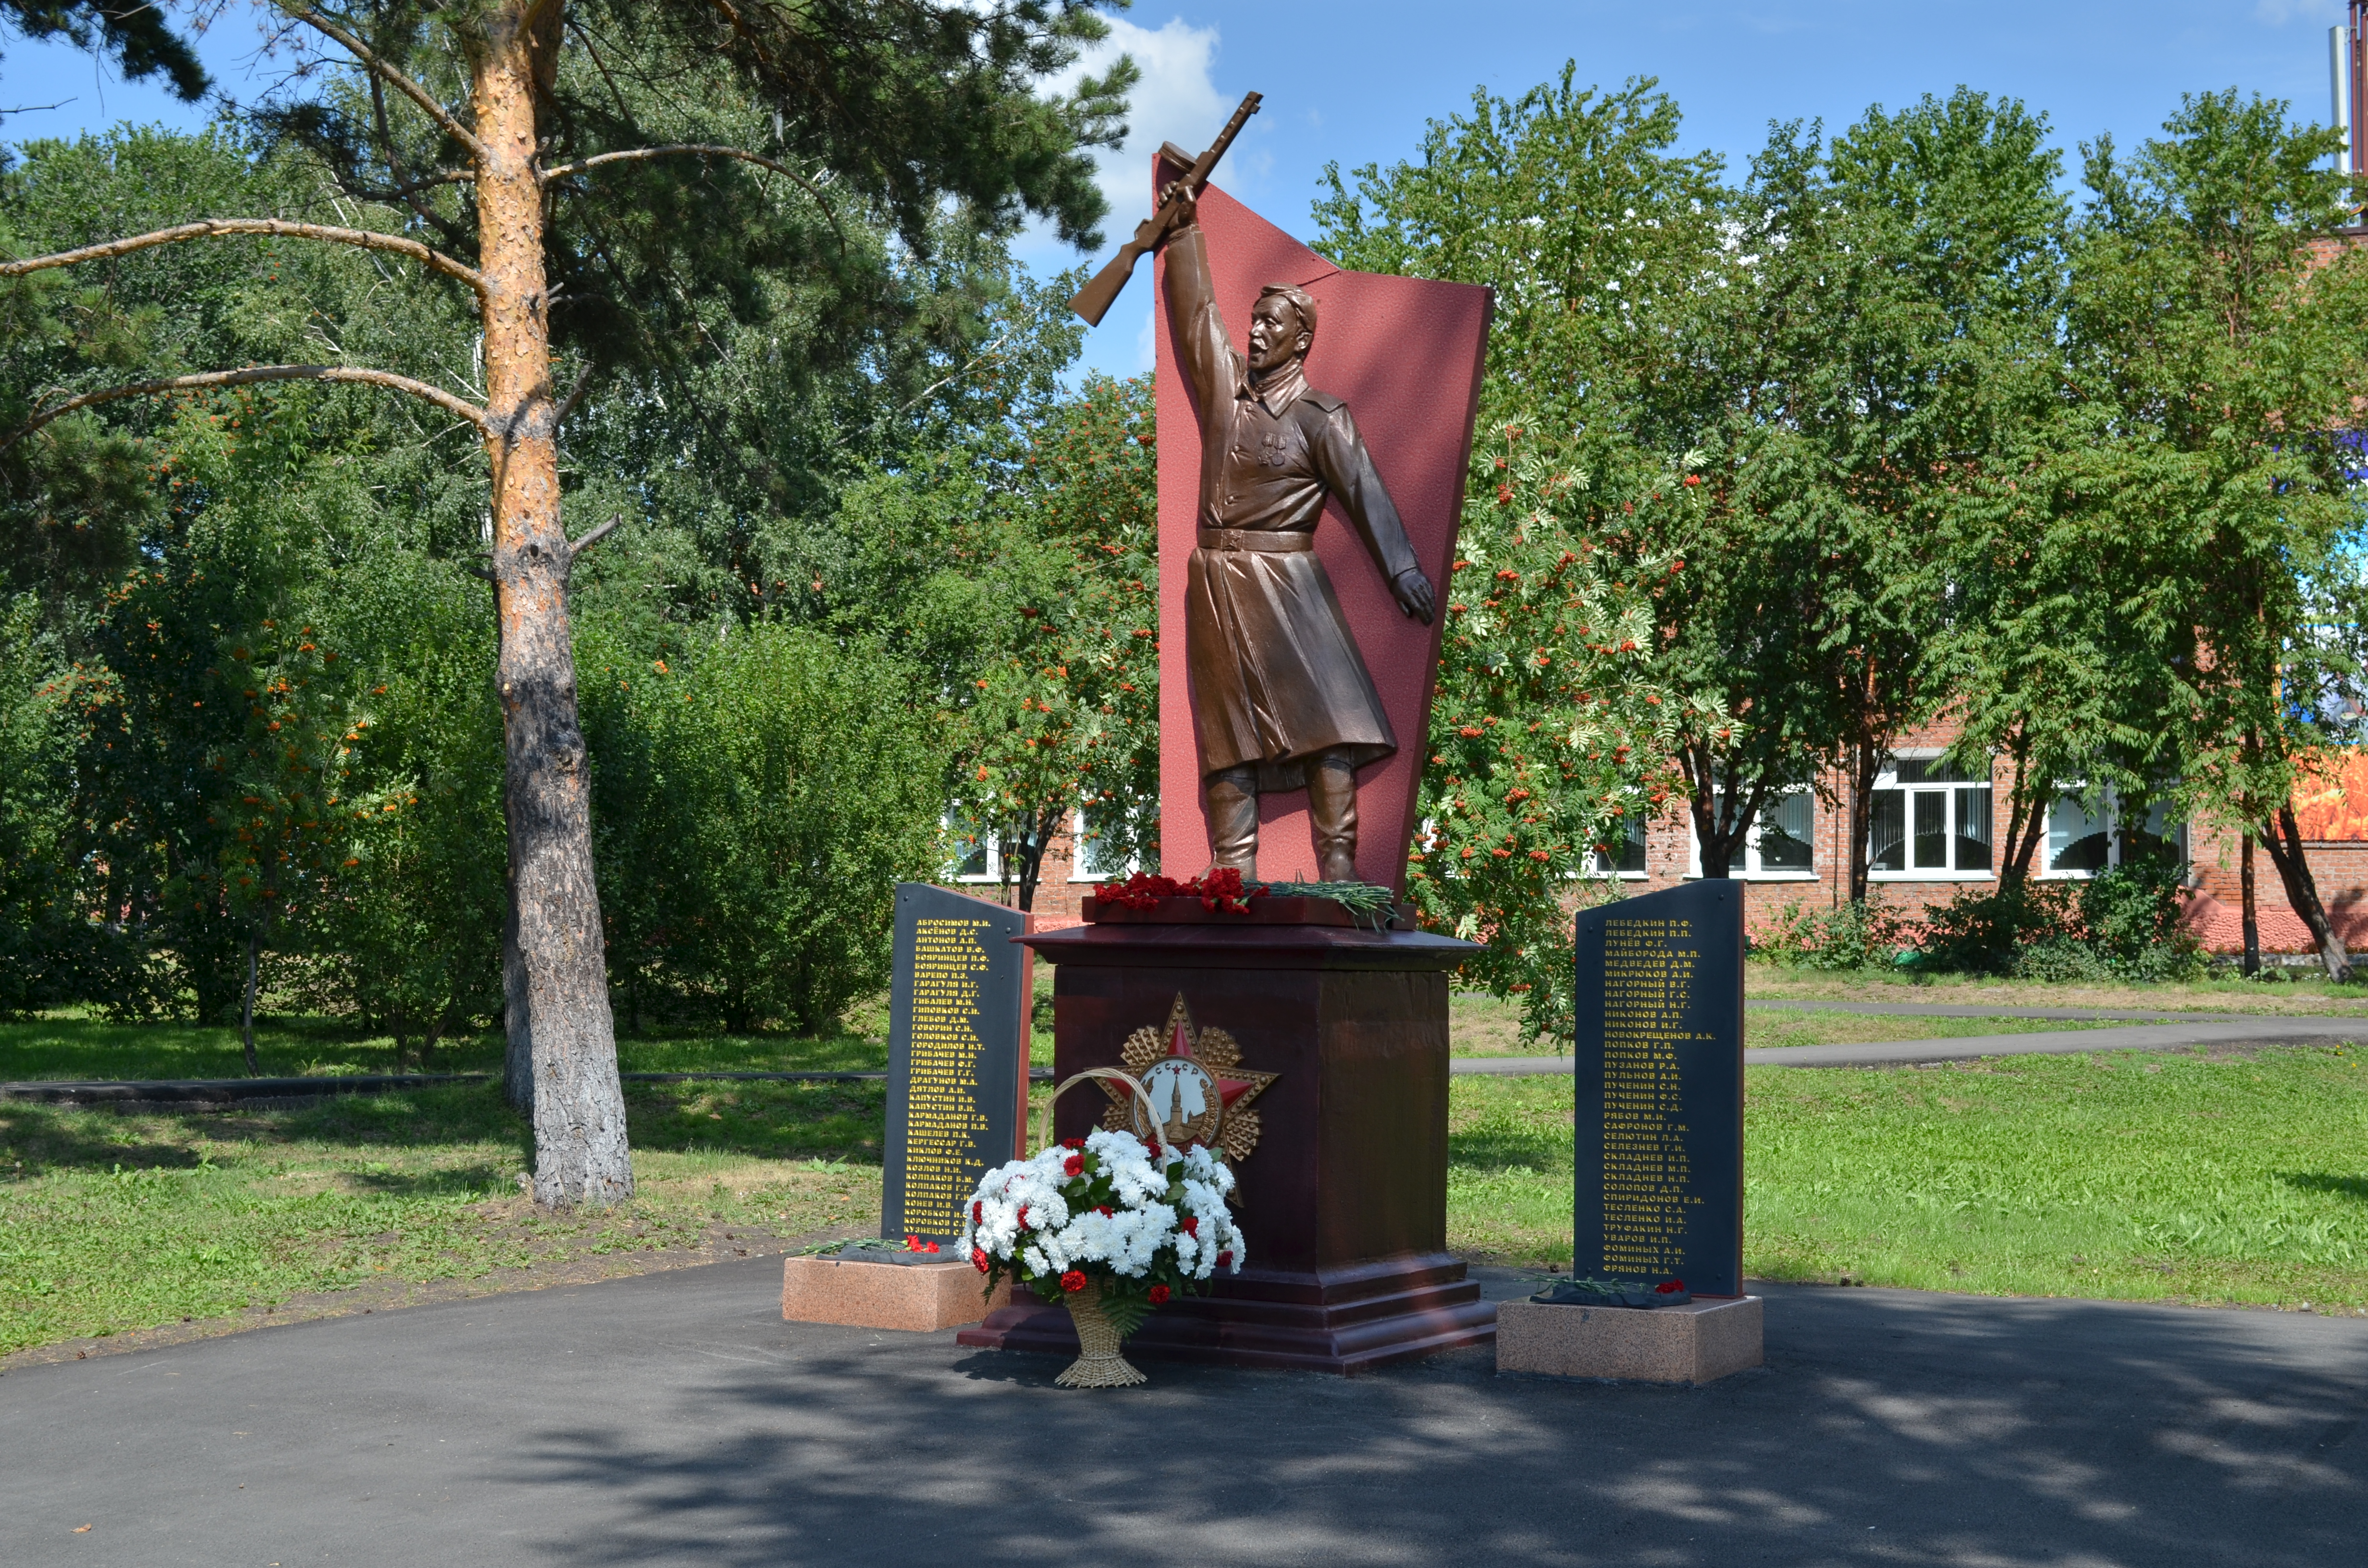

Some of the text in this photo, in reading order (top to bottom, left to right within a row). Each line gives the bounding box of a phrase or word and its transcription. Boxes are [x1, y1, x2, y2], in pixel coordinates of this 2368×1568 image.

[1605, 919, 1665, 928] ЛЕБЕДКИН
[1605, 929, 1692, 938] ЛЕБЕДКИН П.П.
[1605, 938, 1640, 947] ЛУНЁВ
[915, 954, 968, 962] БОЯРИНЦЕВ
[1605, 948, 1701, 959] МАЙБОРОДА М.П.
[914, 962, 967, 971] БОЯРИНЦЕВ
[1605, 959, 1695, 970] МЕДВЕДЕВ Д.М.
[1605, 969, 1694, 979] МИКРЮКОВ А.И.
[1605, 978, 1690, 988] НАГОРНЫЙ В.Г.
[913, 989, 958, 997] ГАРАГУЛЯ
[1605, 988, 1690, 999] НАГОРНЫЙ Г.С.
[1605, 998, 1691, 1009] НАГОРНЫЙ Н.Г.
[912, 1015, 946, 1023] ГЛЕБОВ
[1604, 1010, 1683, 1019] НИКОНОВ А.П.
[912, 1023, 952, 1031] ГОВОРИН
[1604, 1020, 1682, 1029] НИКОНОВ И.Г.
[912, 1032, 958, 1041] ГОЛОВКОВ
[1604, 1030, 1691, 1041] НОВОКРЕЩЕНОВ
[911, 1041, 965, 1050] ГОРОДИЛОВ
[1604, 1041, 1675, 1050] ПОПКОВ Г.П.
[911, 1050, 955, 1058] ГРИБАЧЕВ
[1604, 1051, 1677, 1060] ПОПКОВ М.Ф.
[911, 1058, 955, 1067] ГРИБАЧЕВ
[1604, 1061, 1680, 1070] ПУЗАНОВ Р.А.
[910, 1067, 954, 1076] ГРИБАЧЕВ
[1604, 1071, 1655, 1079] ПУЛЬНОВ
[909, 1076, 957, 1085] ДРАГУНОВ
[1604, 1081, 1655, 1090] ПУЧЕНИН
[909, 1093, 955, 1102] КАПУСТИН
[1604, 1091, 1655, 1100] ПУЧЕНИН
[909, 1102, 955, 1111] КАПУСТИН
[1604, 1102, 1682, 1112] ПУЧЕНИН С.Д.
[908, 1111, 968, 1121] КАРМАДАНОВ
[1604, 1112, 1639, 1120] РЯБОВ
[908, 1120, 968, 1129] КАРМАДАНОВ
[1603, 1122, 1663, 1131] САФРОНОВ
[908, 1129, 949, 1138] КАШЕЛЕВ
[1603, 1132, 1657, 1141] СЕЛЮТИН
[907, 1138, 957, 1147] КЕРГЕССАР
[1603, 1142, 1659, 1151] СЕЛЕЗНЕВ
[907, 1146, 942, 1154] КИКЛОВ
[906, 1155, 962, 1164] КЛЮЧНИКОВ
[1603, 1152, 1663, 1162] СКЛАДНЕВ
[906, 1164, 941, 1172] КОЗЛОВ
[1603, 1163, 1663, 1172] СКЛАДНЕВ
[906, 1173, 952, 1182] КОЛПАКОВ
[1603, 1173, 1663, 1182] СКЛАДНЕВ
[905, 1182, 952, 1191] КОЛПАКОВ
[1603, 1183, 1683, 1194] СОЛОПОВ Д.П.
[905, 1190, 952, 1200] КОЛПАКОВ
[1603, 1193, 1678, 1203] СПИРИДОНОВ
[905, 1199, 933, 1207] КОНЕВ
[904, 1208, 950, 1217] КОРОБКОВ
[1603, 1203, 1661, 1213] ТЕСЛЕНКО
[904, 1217, 950, 1226] КОРОБКОВ
[1603, 1213, 1687, 1224] ТЕСЛЕНКО И.А.
[903, 1225, 950, 1236] КУЗНЕЦОВ
[1603, 1224, 1662, 1233] ТРУФАКИН
[1603, 1234, 1672, 1244] УВАРОВ И.П.
[1603, 1244, 1659, 1253] ФОМИНЫХ
[1603, 1254, 1684, 1265] ФОМИНЫХ Г.Т.
[1603, 1264, 1647, 1274] ФРЯНОВ
